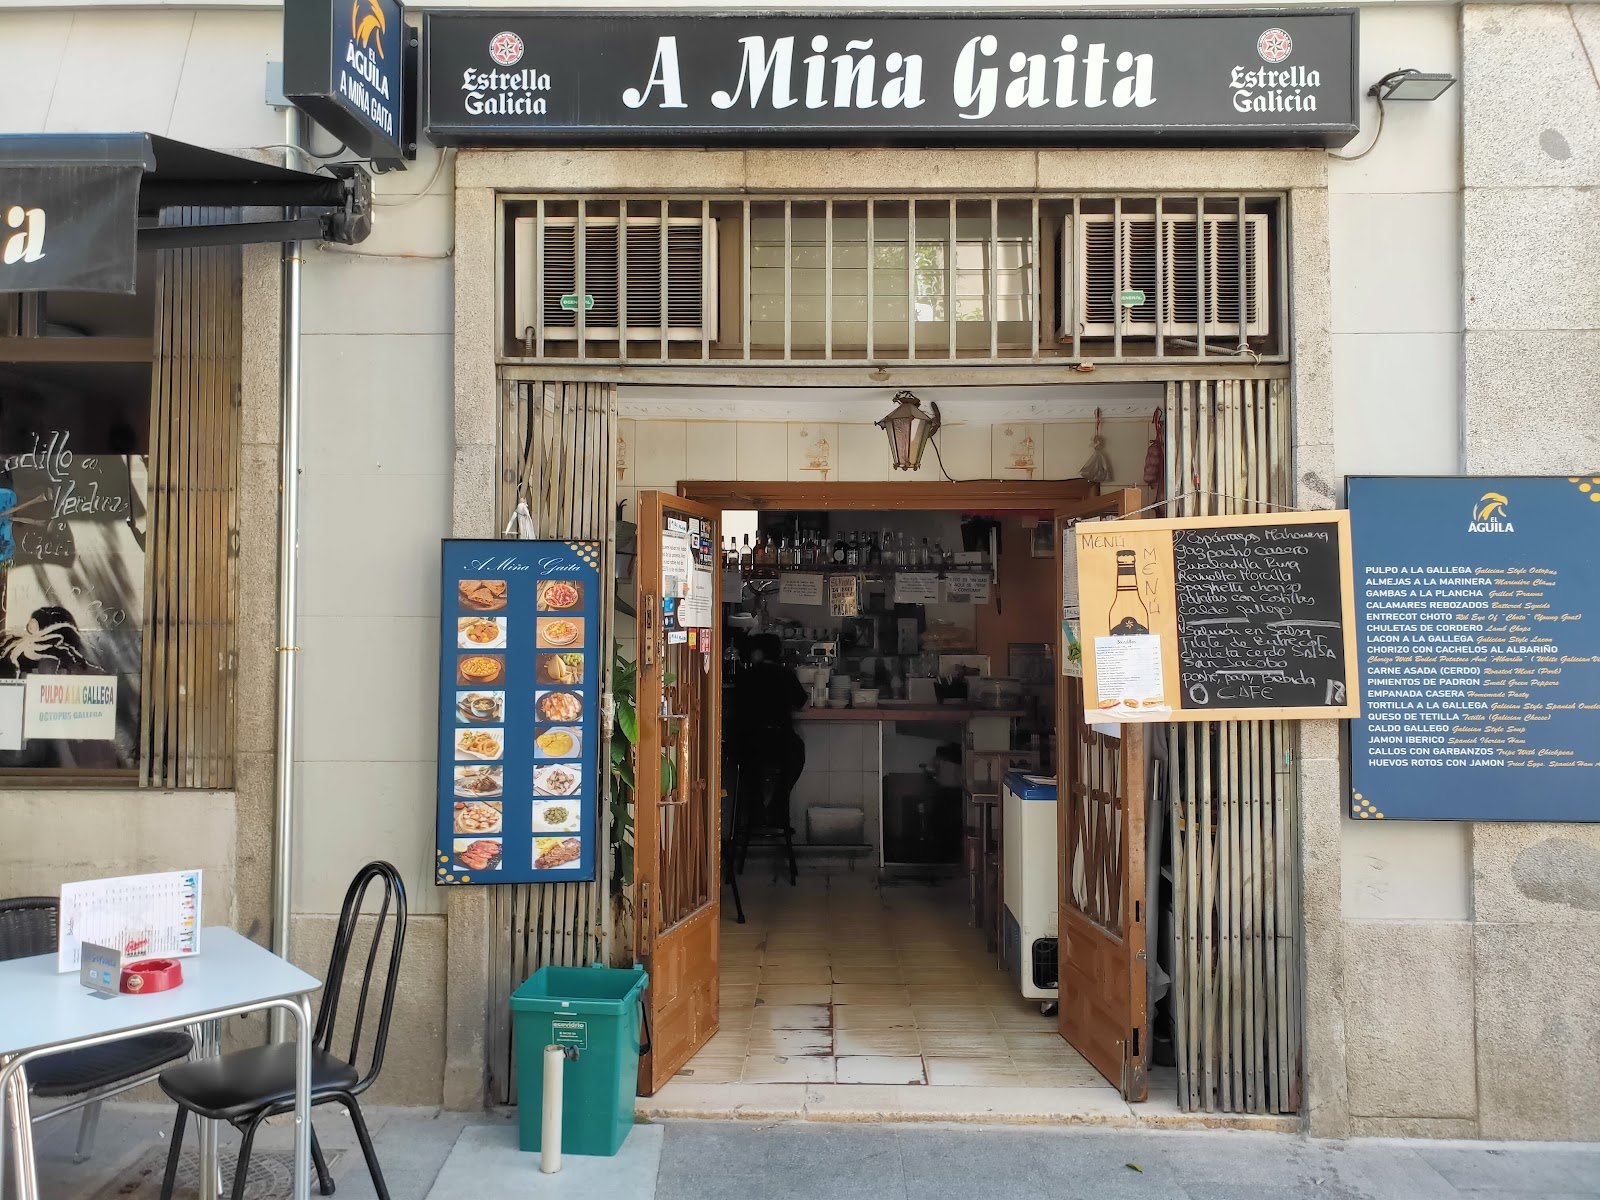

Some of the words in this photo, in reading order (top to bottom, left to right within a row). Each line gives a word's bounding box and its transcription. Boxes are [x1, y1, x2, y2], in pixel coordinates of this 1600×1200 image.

[368, 48, 376, 64] EL
[346, 40, 389, 100] ÁGUILA
[461, 68, 551, 90] Estrella
[623, 36, 688, 109] A
[711, 34, 926, 110] Miña
[953, 34, 1157, 120] Gaita
[1229, 66, 1320, 88] Estrella
[340, 70, 347, 96] A
[348, 76, 370, 116] MIÑA
[371, 98, 392, 136] GAITA
[465, 92, 547, 114] Galicia
[1233, 89, 1317, 112] Galicia
[1468, 522, 1514, 532] ÁGUILA
[1506, 645, 1558, 653] ALBARIÑO
[1440, 667, 1480, 675] (CERDO)
[40, 685, 64, 704] PULPO
[82, 686, 114, 704] GALLEGA
